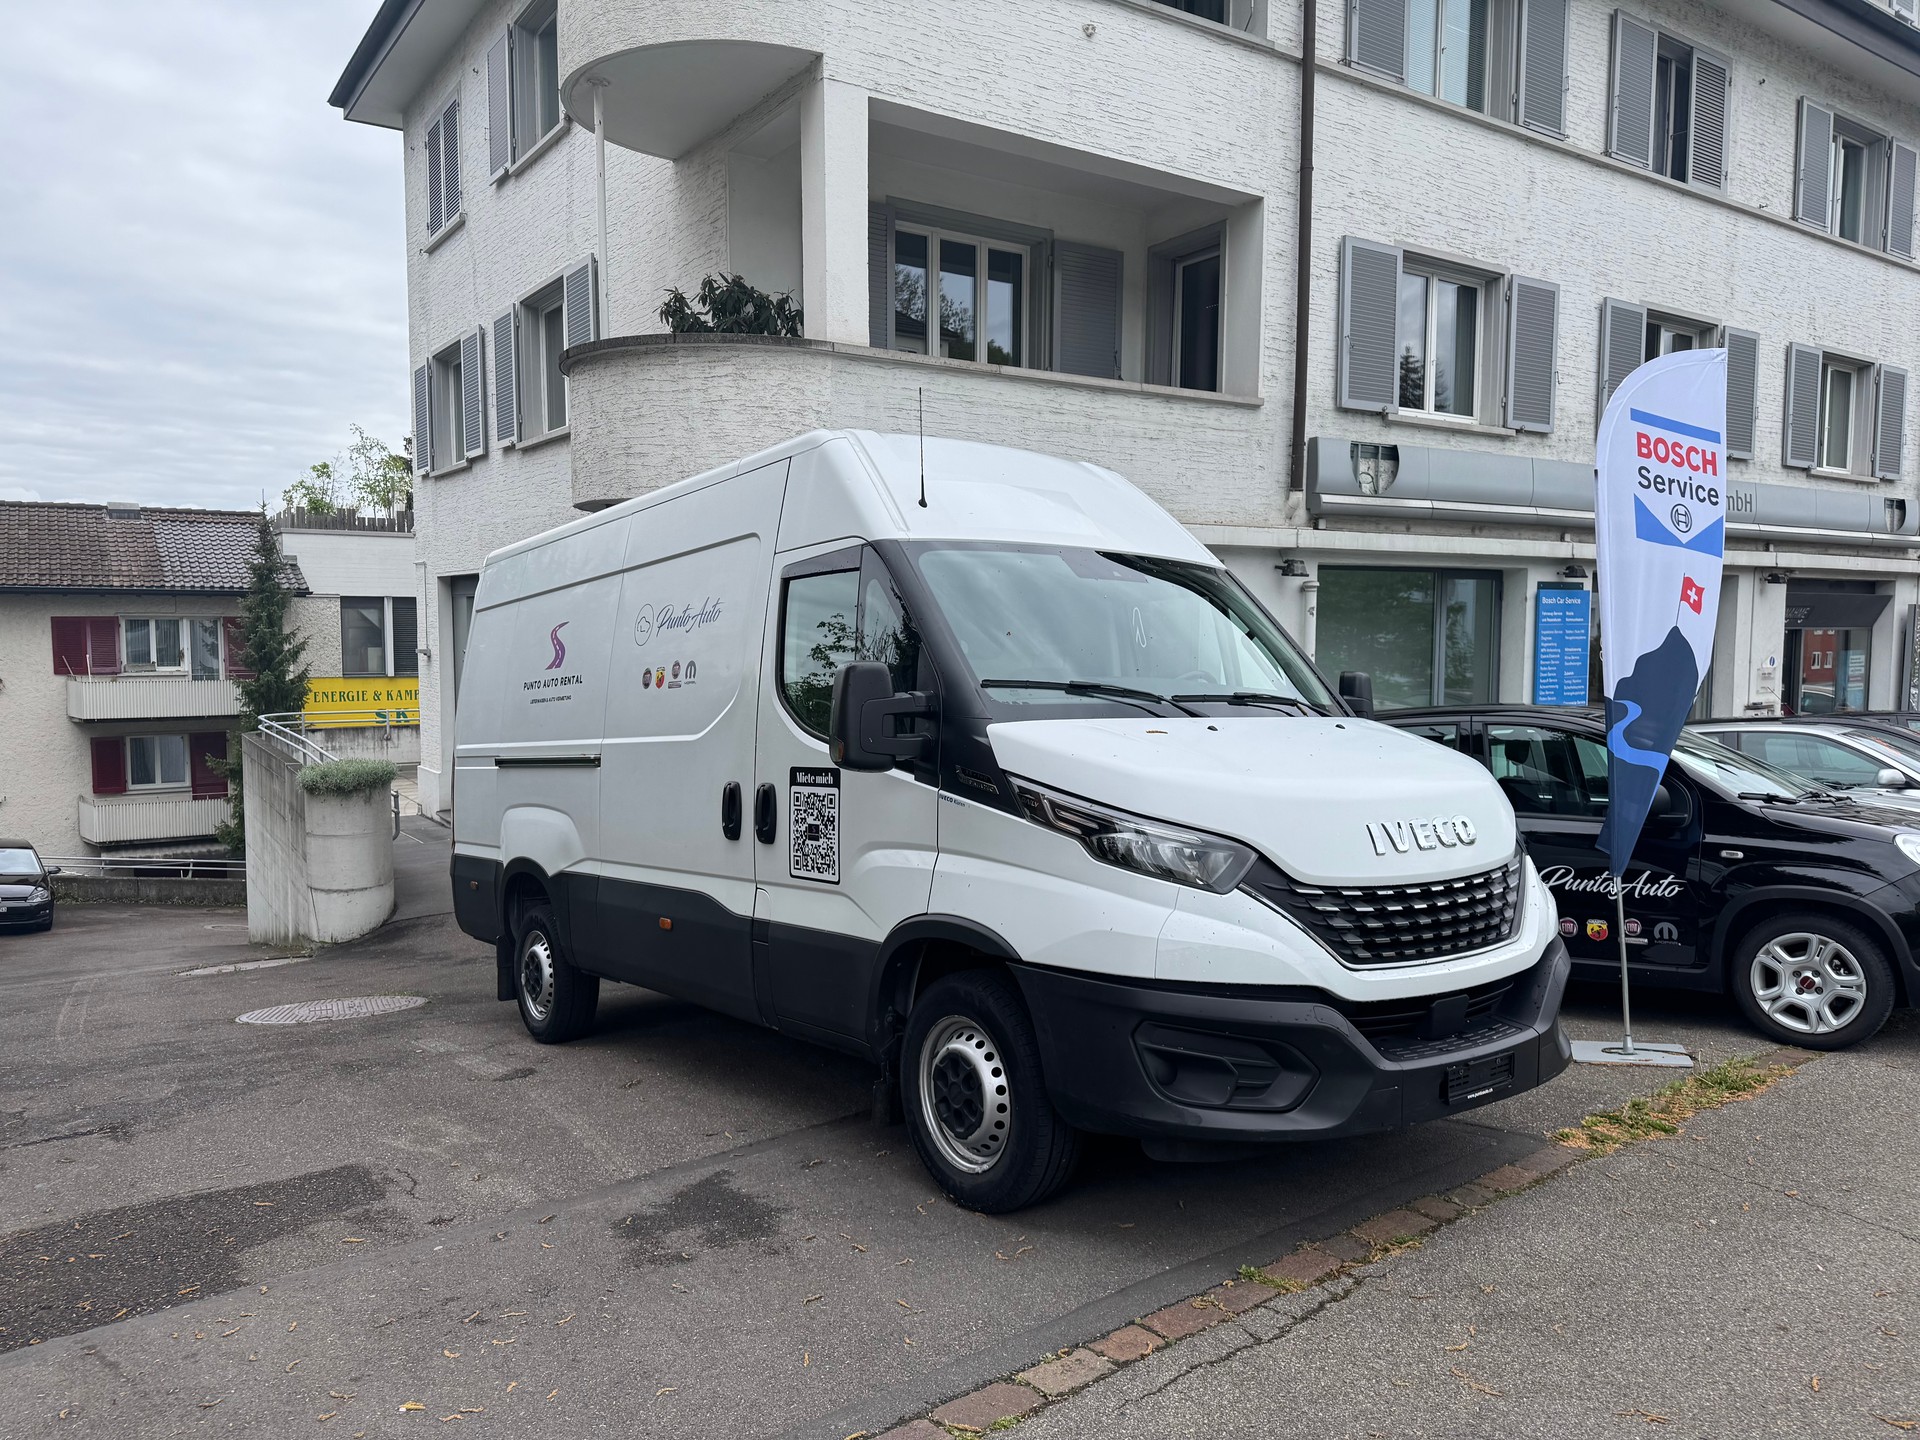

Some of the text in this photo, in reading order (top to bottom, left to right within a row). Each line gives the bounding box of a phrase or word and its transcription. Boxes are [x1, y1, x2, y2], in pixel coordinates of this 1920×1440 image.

[1636, 431, 1718, 477] BOSCH
[1637, 465, 1720, 506] Service
[656, 596, 726, 638] Punto Auto
[1542, 596, 1556, 604] Bosch
[1565, 596, 1581, 604] Service
[313, 690, 368, 703] ENERGIE
[372, 690, 382, 702] &
[523, 675, 583, 691] PUNTO AUTO RENTAL
[796, 771, 834, 785] Miete mich
[1366, 815, 1477, 856] IVECO
[1539, 865, 1688, 899] Punto Auto
